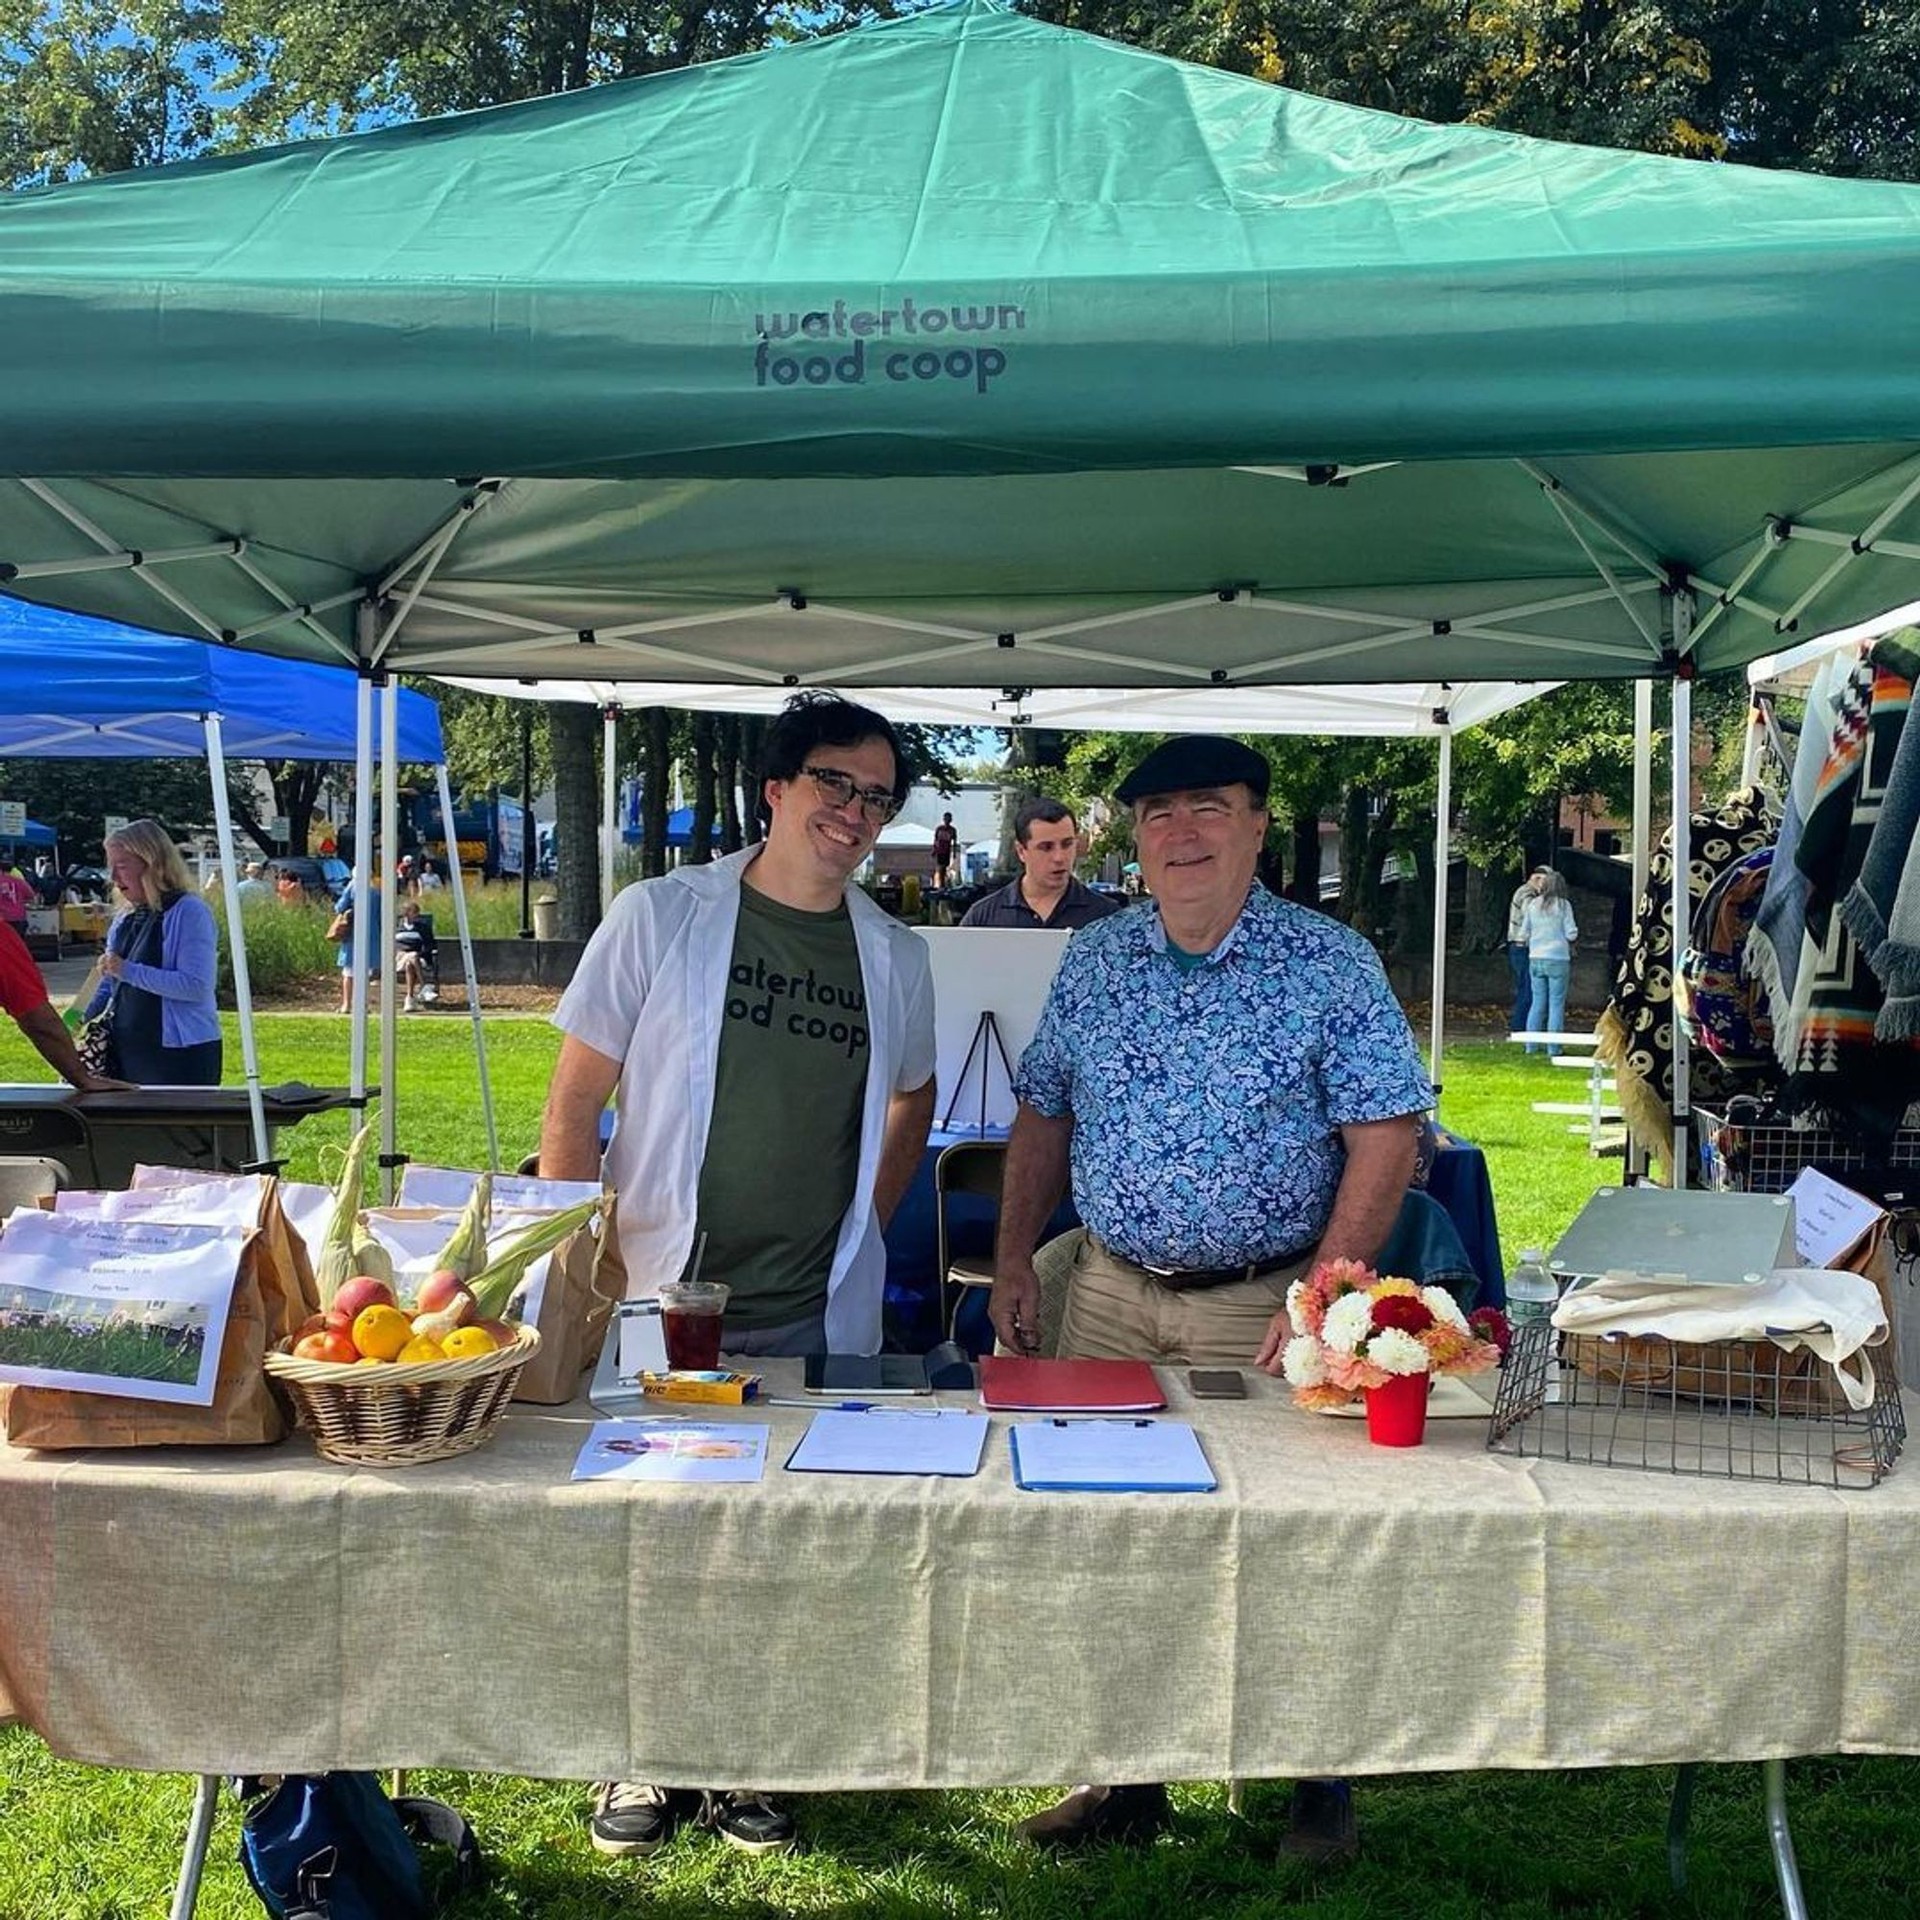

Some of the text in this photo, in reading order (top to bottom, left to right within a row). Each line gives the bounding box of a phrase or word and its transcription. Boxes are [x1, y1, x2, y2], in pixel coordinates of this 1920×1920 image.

[755, 299, 1025, 339] watertown
[755, 339, 1006, 394] food coop
[730, 957, 867, 1012] atertow
[726, 994, 867, 1059] od coop
